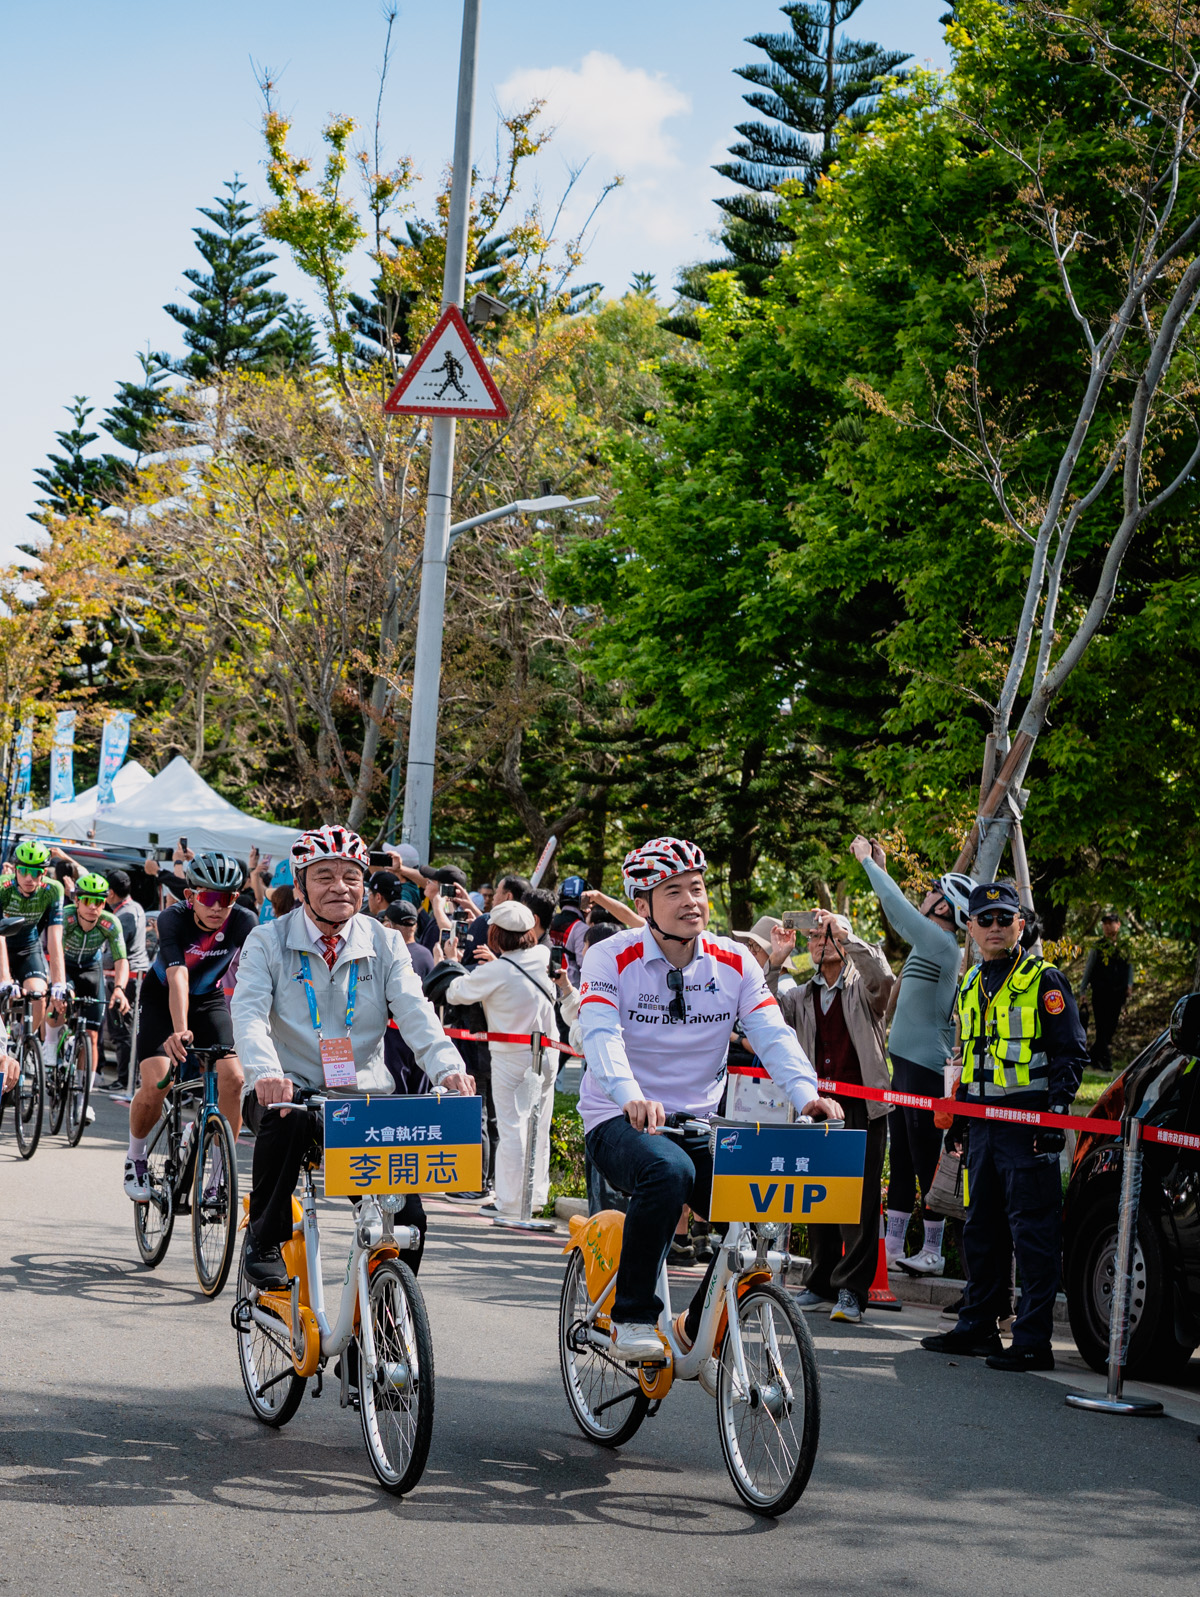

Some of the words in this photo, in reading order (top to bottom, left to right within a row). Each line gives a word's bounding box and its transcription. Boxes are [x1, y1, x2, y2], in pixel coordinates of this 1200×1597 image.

[573, 878, 580, 894] 1
[590, 981, 618, 993] TAIWAN
[638, 993, 660, 1003] 2026
[628, 1009, 660, 1025] Tour
[661, 1013, 679, 1025] De
[682, 1012, 731, 1025] Taiwan
[364, 1125, 442, 1142] 大會執行長
[349, 1150, 458, 1187] 李開志
[749, 1183, 827, 1213] VIP
